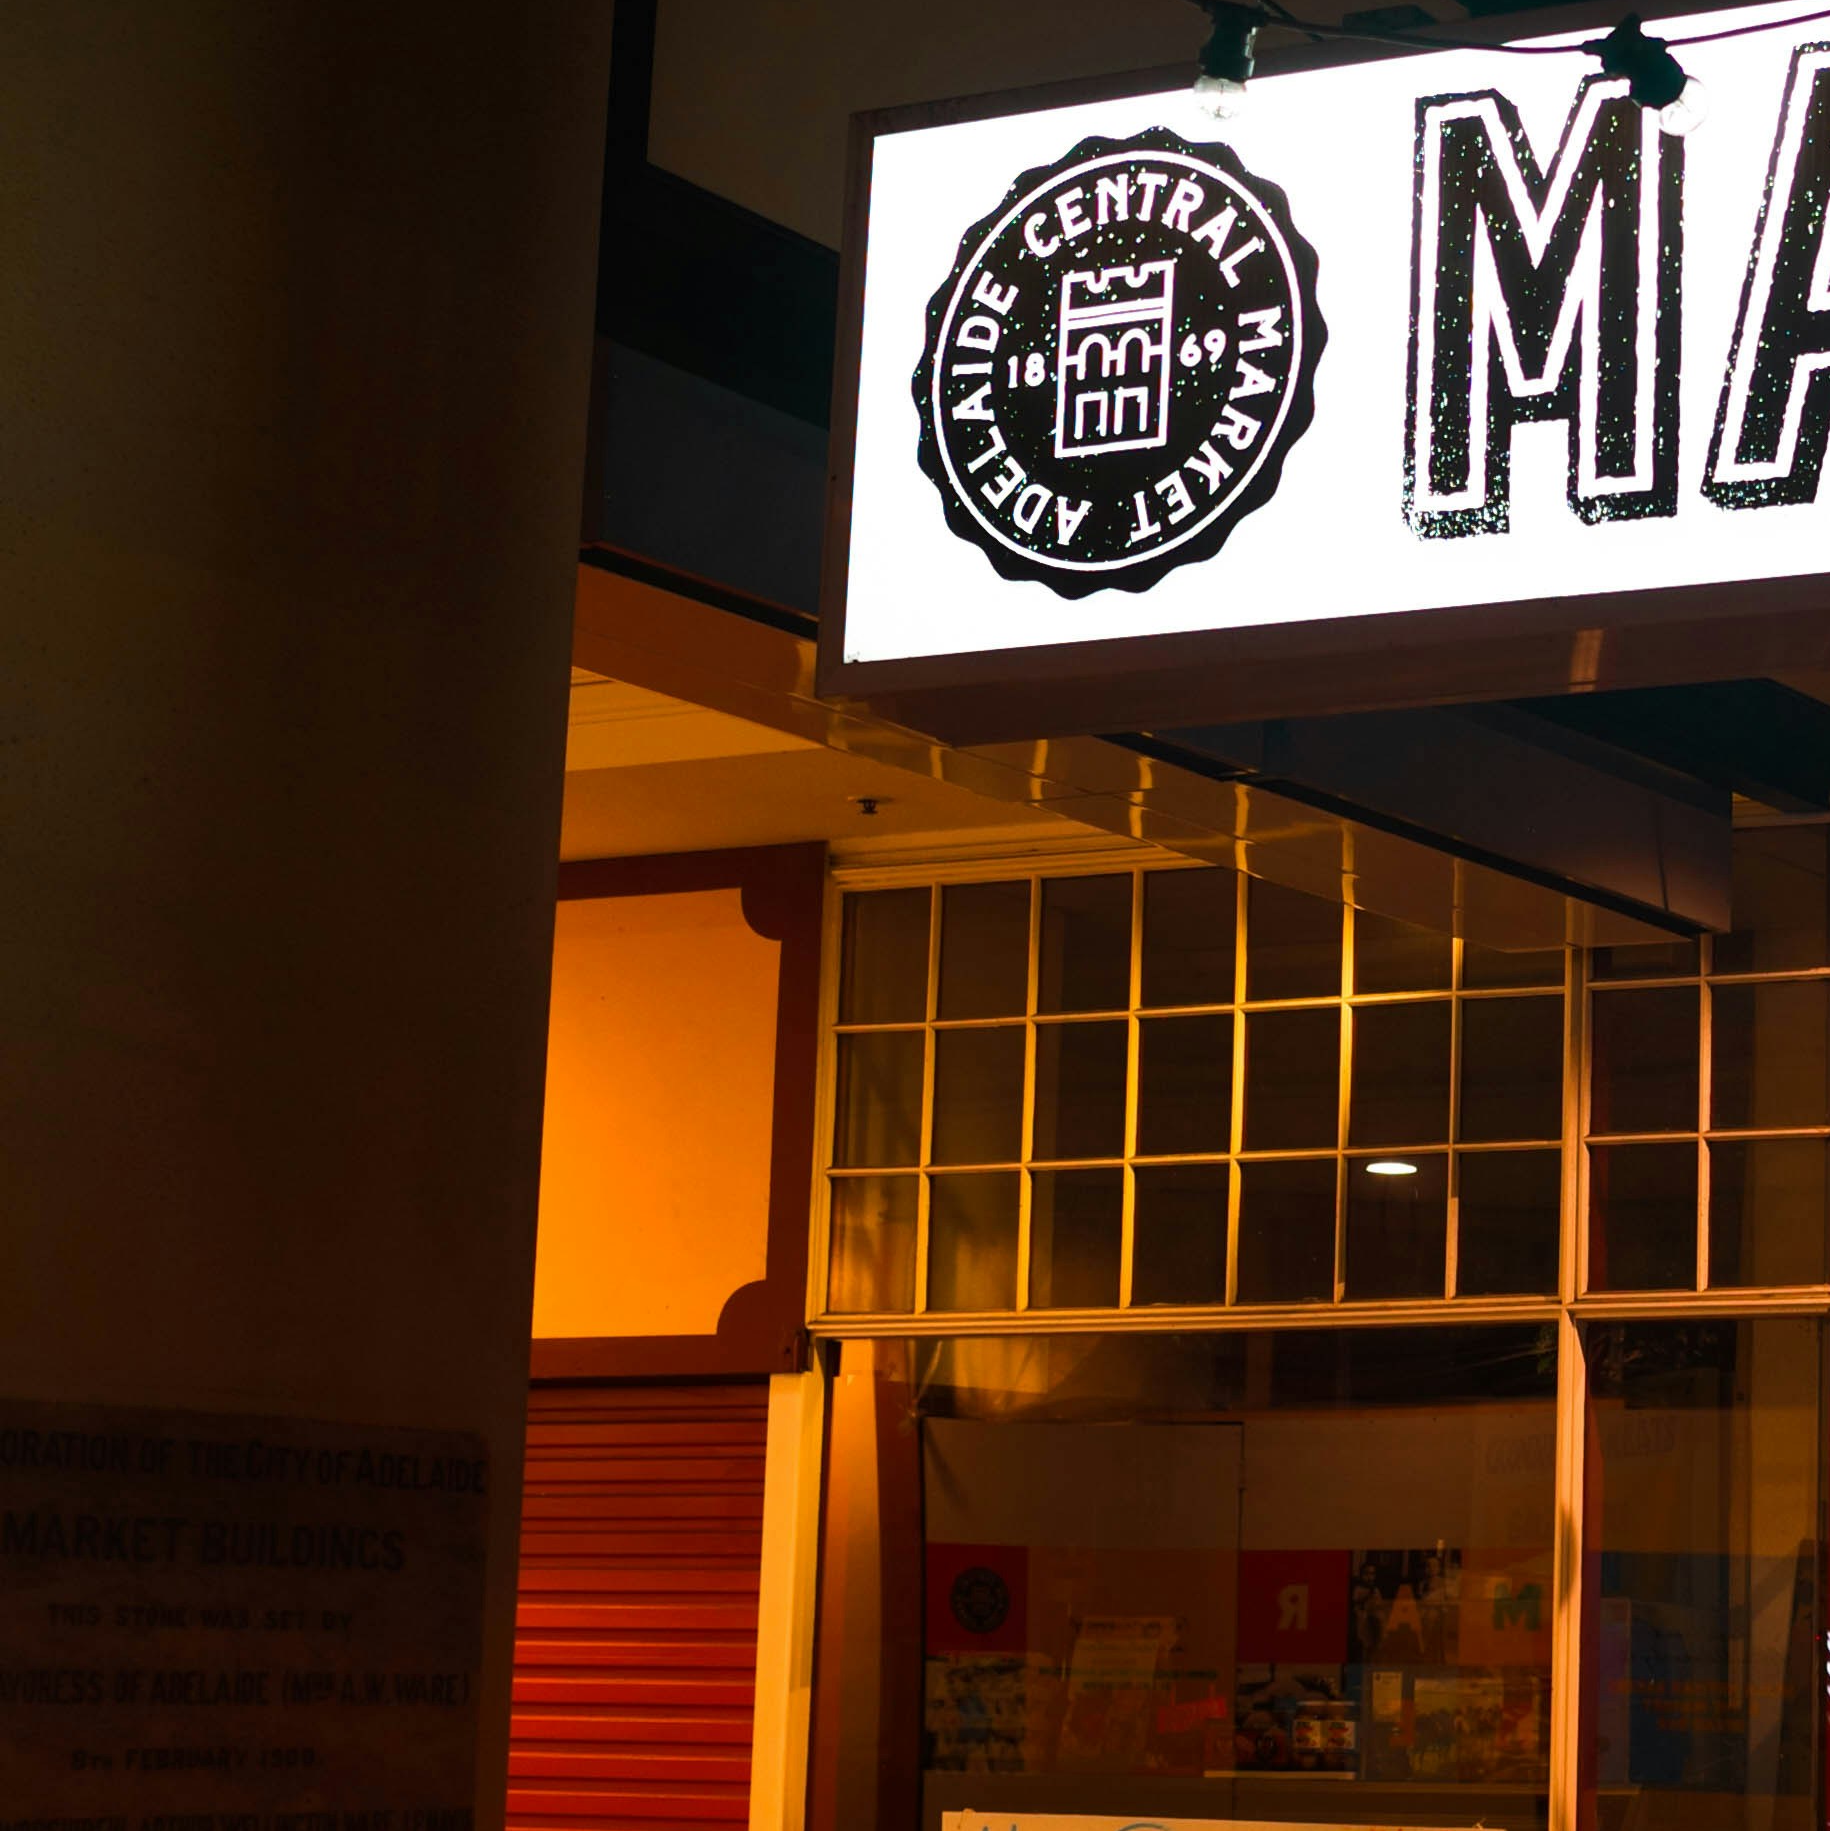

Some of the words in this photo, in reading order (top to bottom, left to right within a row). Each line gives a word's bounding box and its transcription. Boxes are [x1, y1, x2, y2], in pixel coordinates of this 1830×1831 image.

[1021, 171, 1266, 289] CENTRAL
[951, 271, 1093, 546] ADELAIDE
[1006, 351, 1047, 389] 18
[1178, 327, 1228, 369] 69
[1126, 305, 1284, 543] MARKET
[1, 1509, 190, 1564] MARKET
